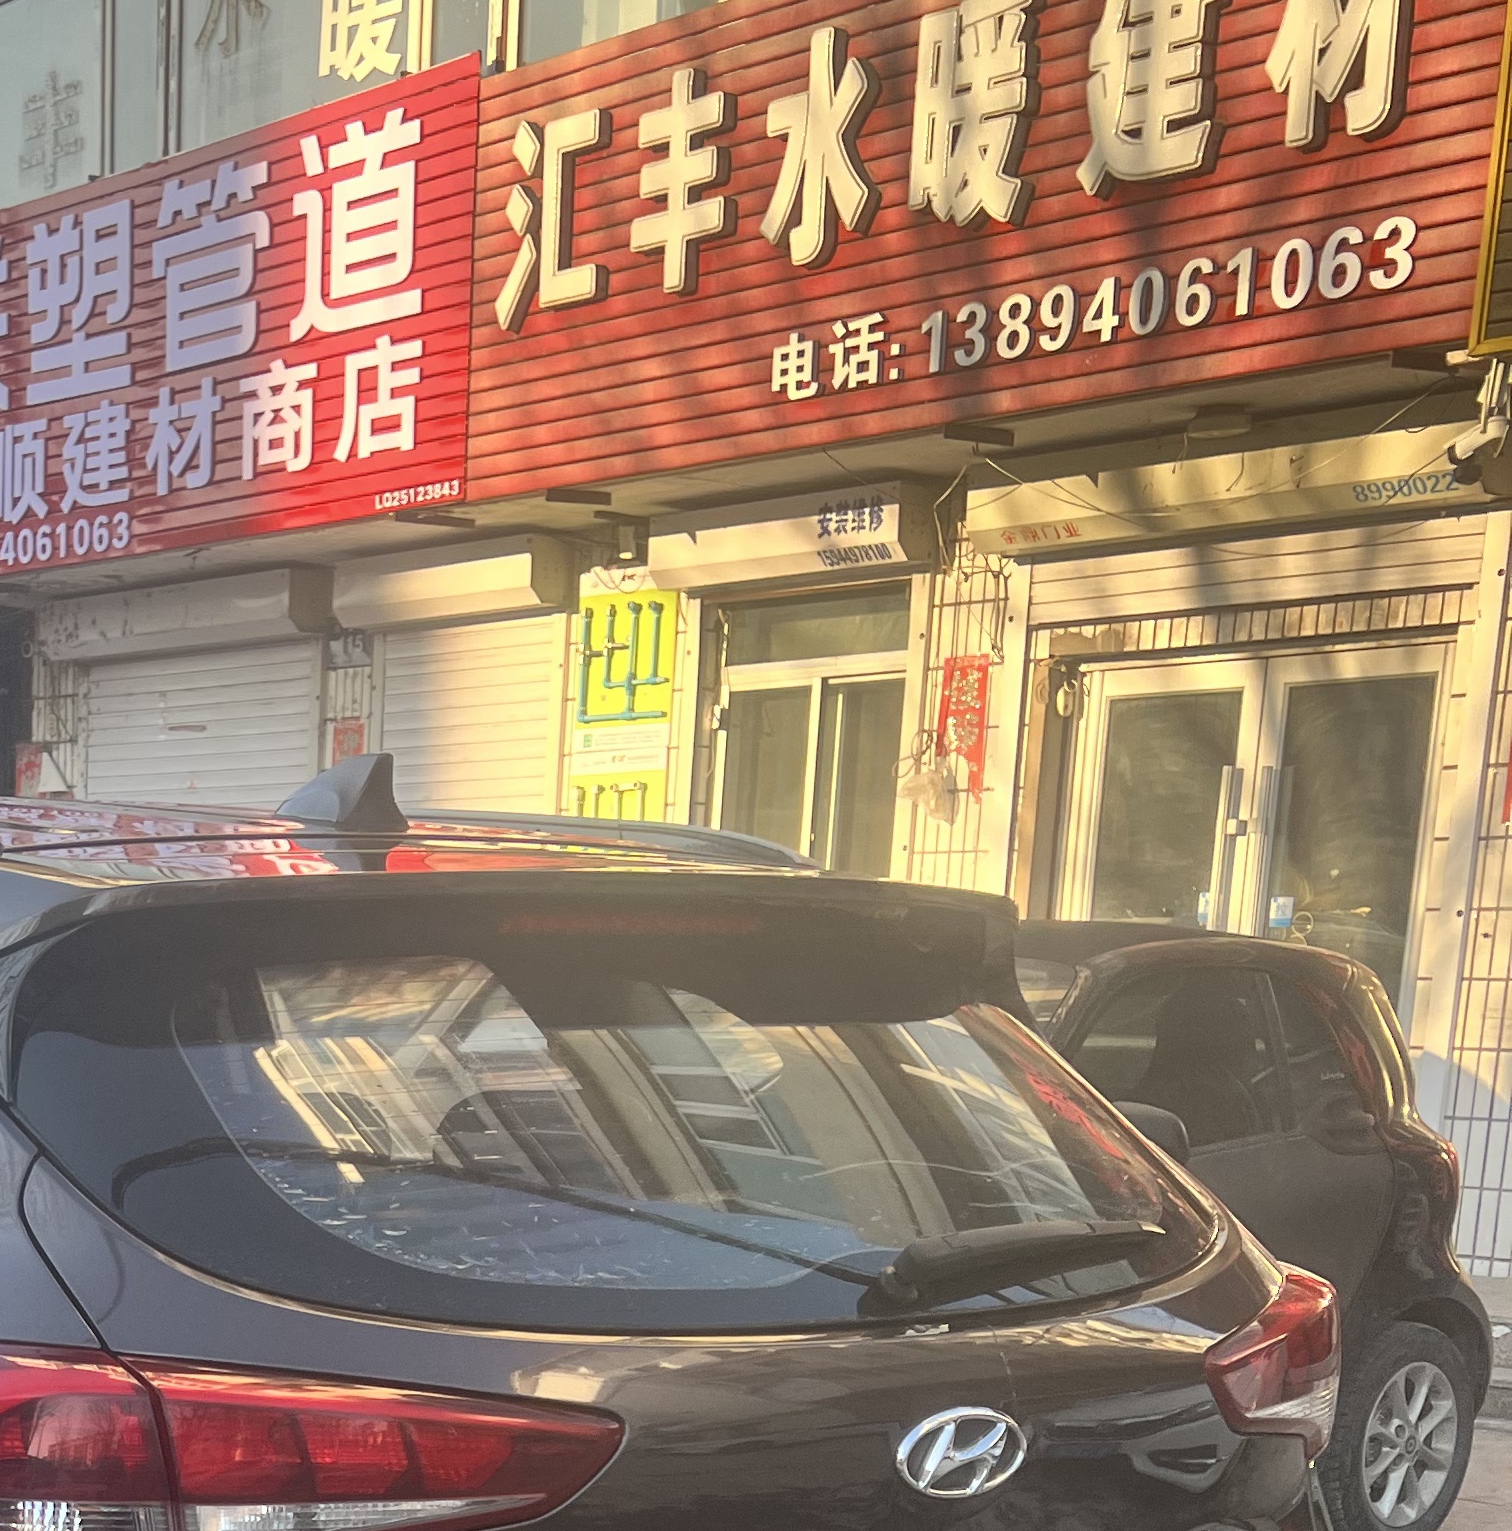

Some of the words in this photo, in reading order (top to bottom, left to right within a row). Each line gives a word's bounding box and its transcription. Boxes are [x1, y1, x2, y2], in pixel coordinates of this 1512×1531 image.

[1352, 472, 1460, 503] 8990022
[817, 495, 884, 539] 安装维修
